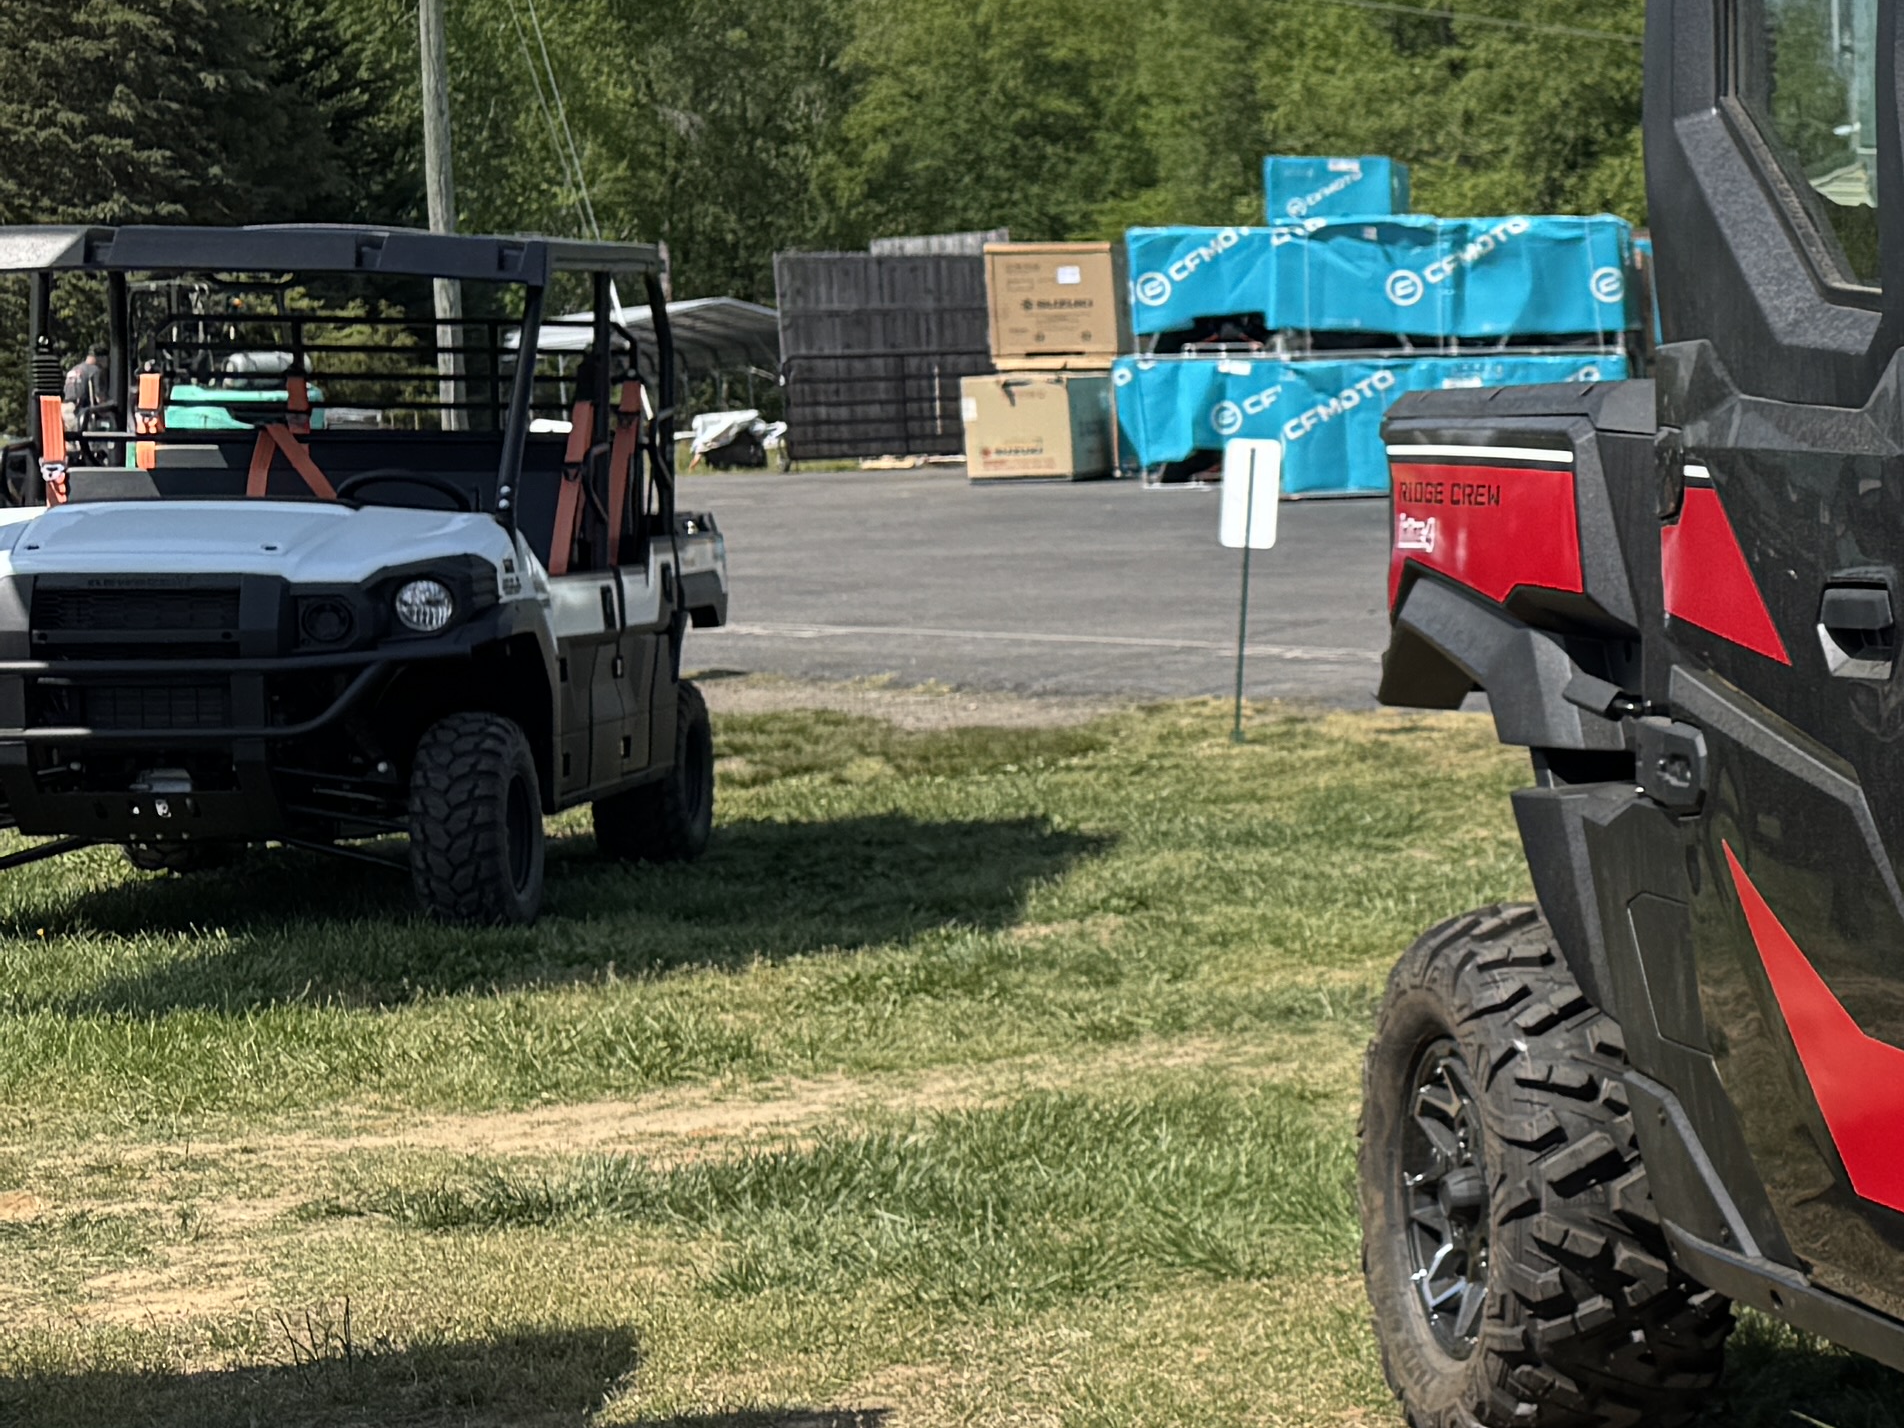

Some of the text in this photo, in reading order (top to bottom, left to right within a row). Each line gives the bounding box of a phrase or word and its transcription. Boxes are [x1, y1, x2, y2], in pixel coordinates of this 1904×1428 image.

[1283, 370, 1395, 440] CFMOTO
[1400, 482, 1501, 506] RIDGE CREW
